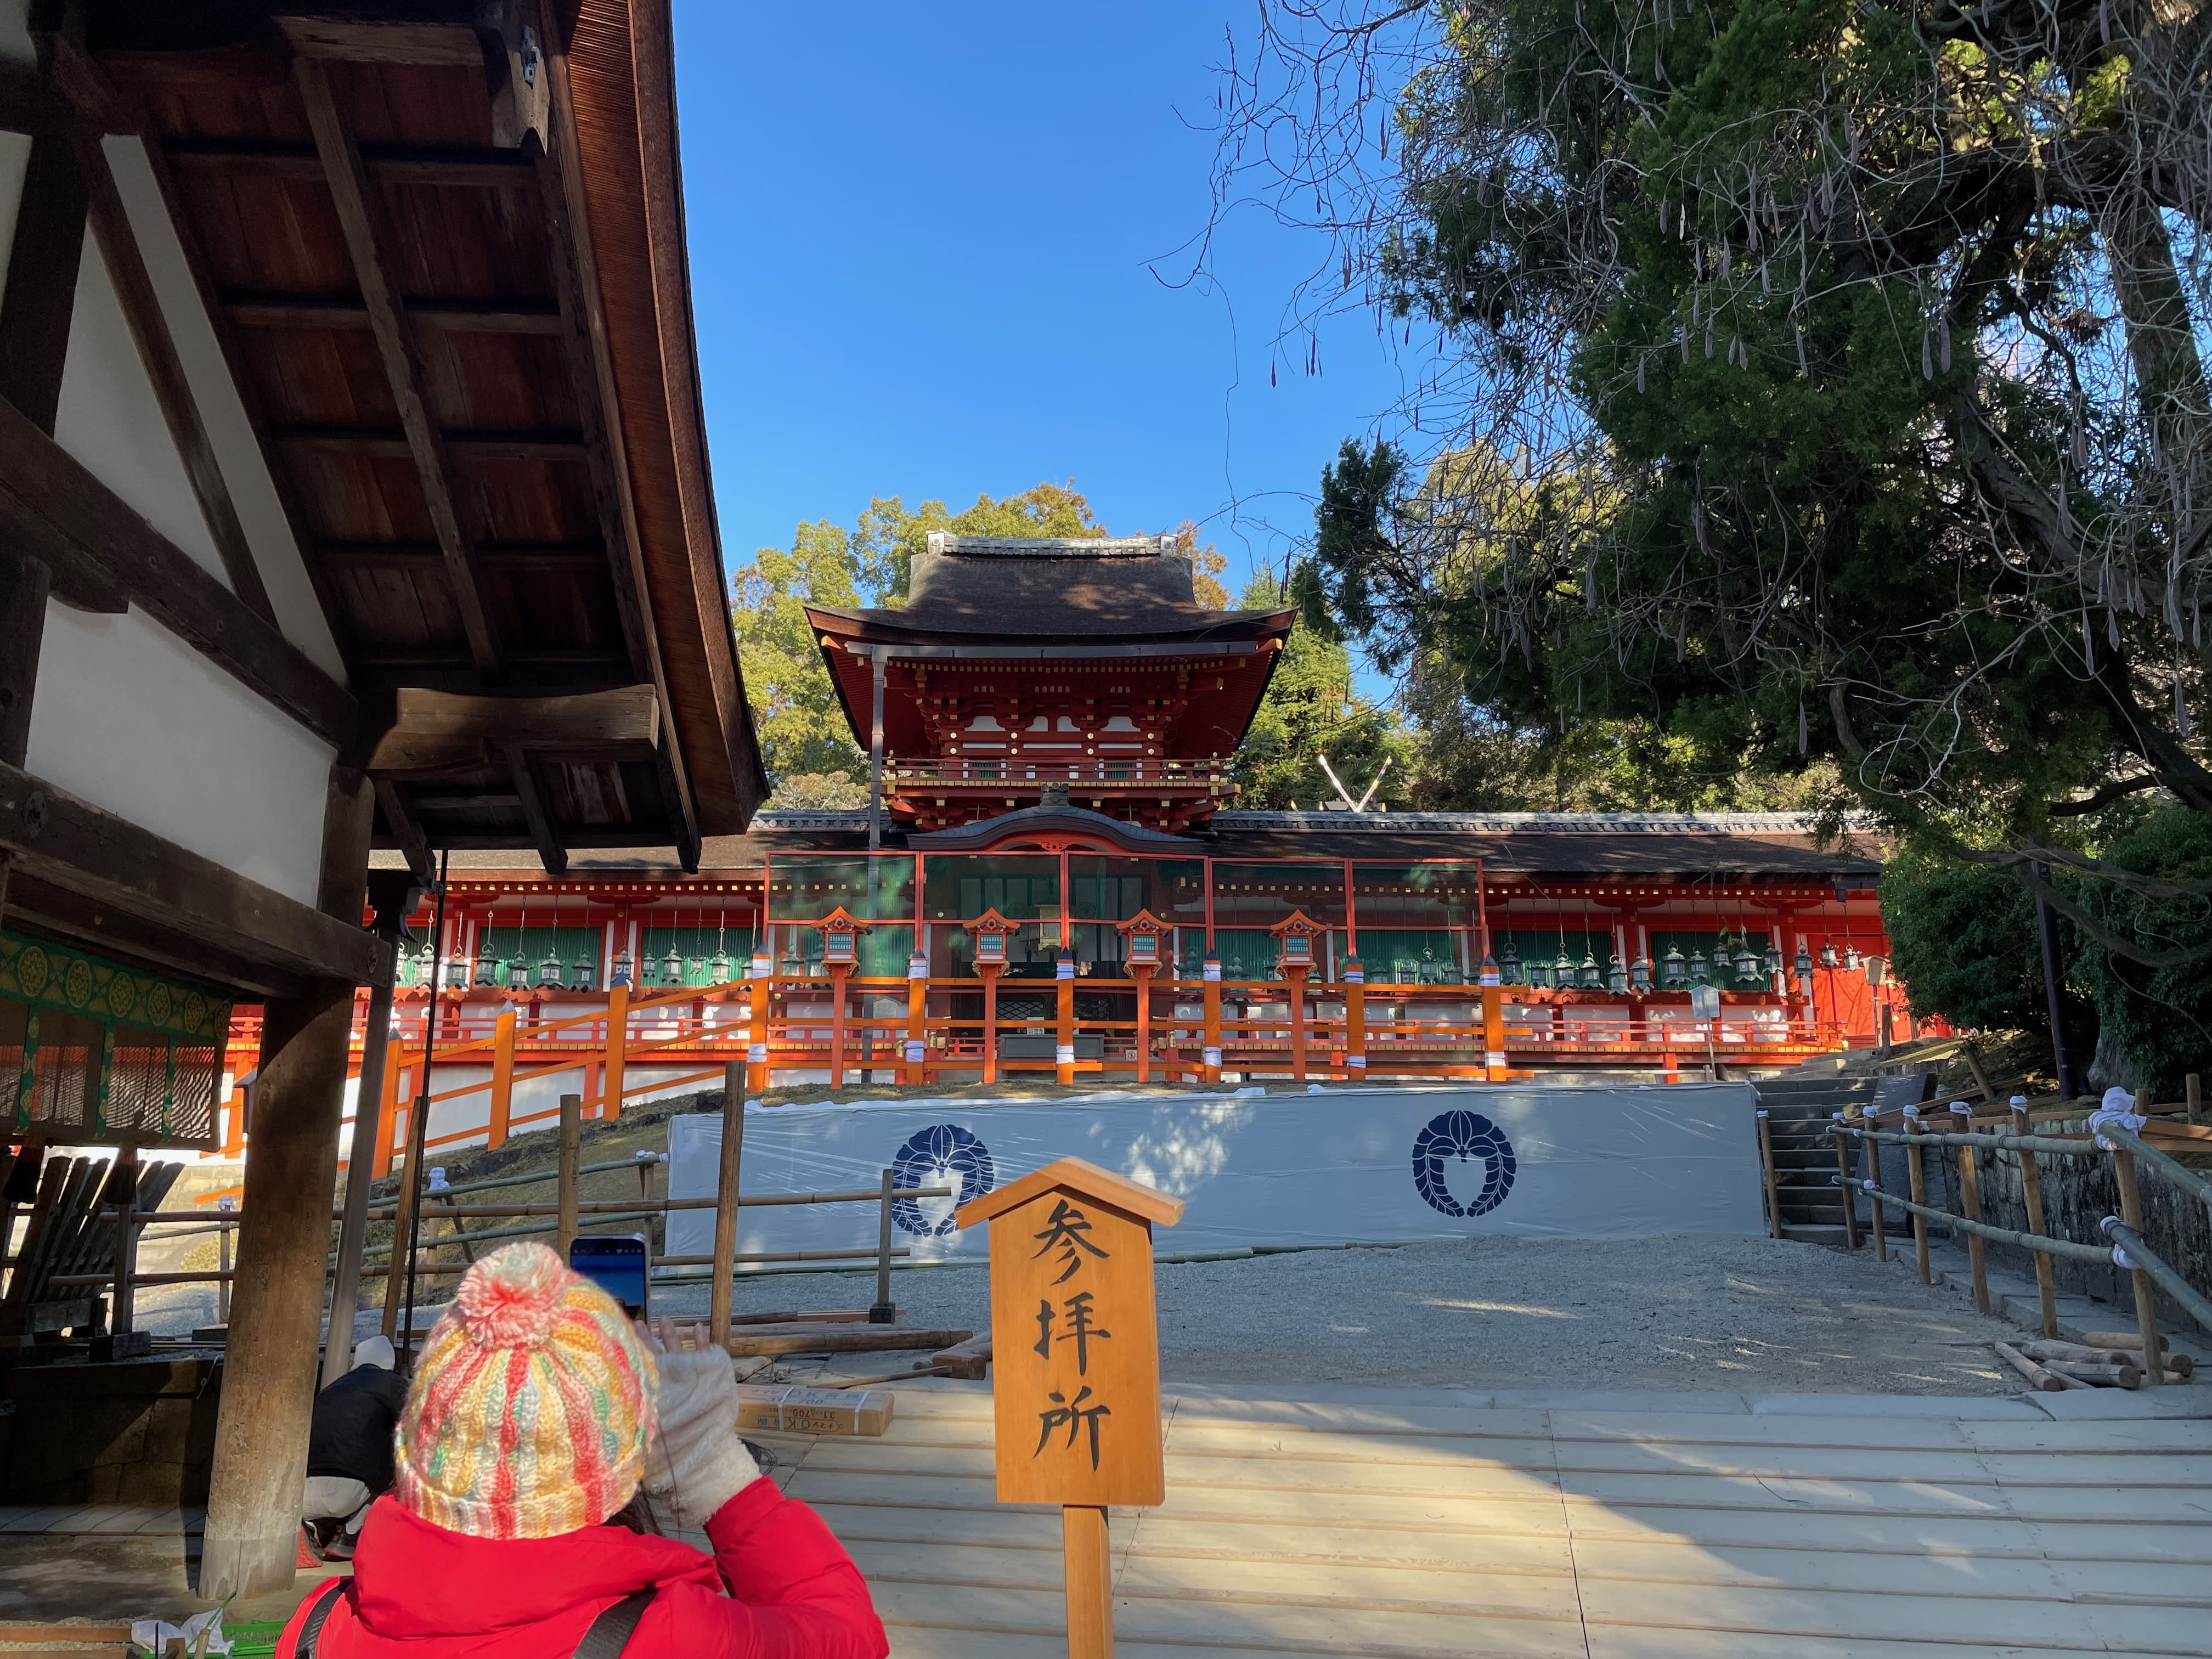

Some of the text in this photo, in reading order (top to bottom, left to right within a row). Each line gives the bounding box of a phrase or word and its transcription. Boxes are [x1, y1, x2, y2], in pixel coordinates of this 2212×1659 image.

[1031, 1199, 1111, 1472] 参拝所
[792, 1408, 810, 1418] 700
[823, 1411, 836, 1419] 31
